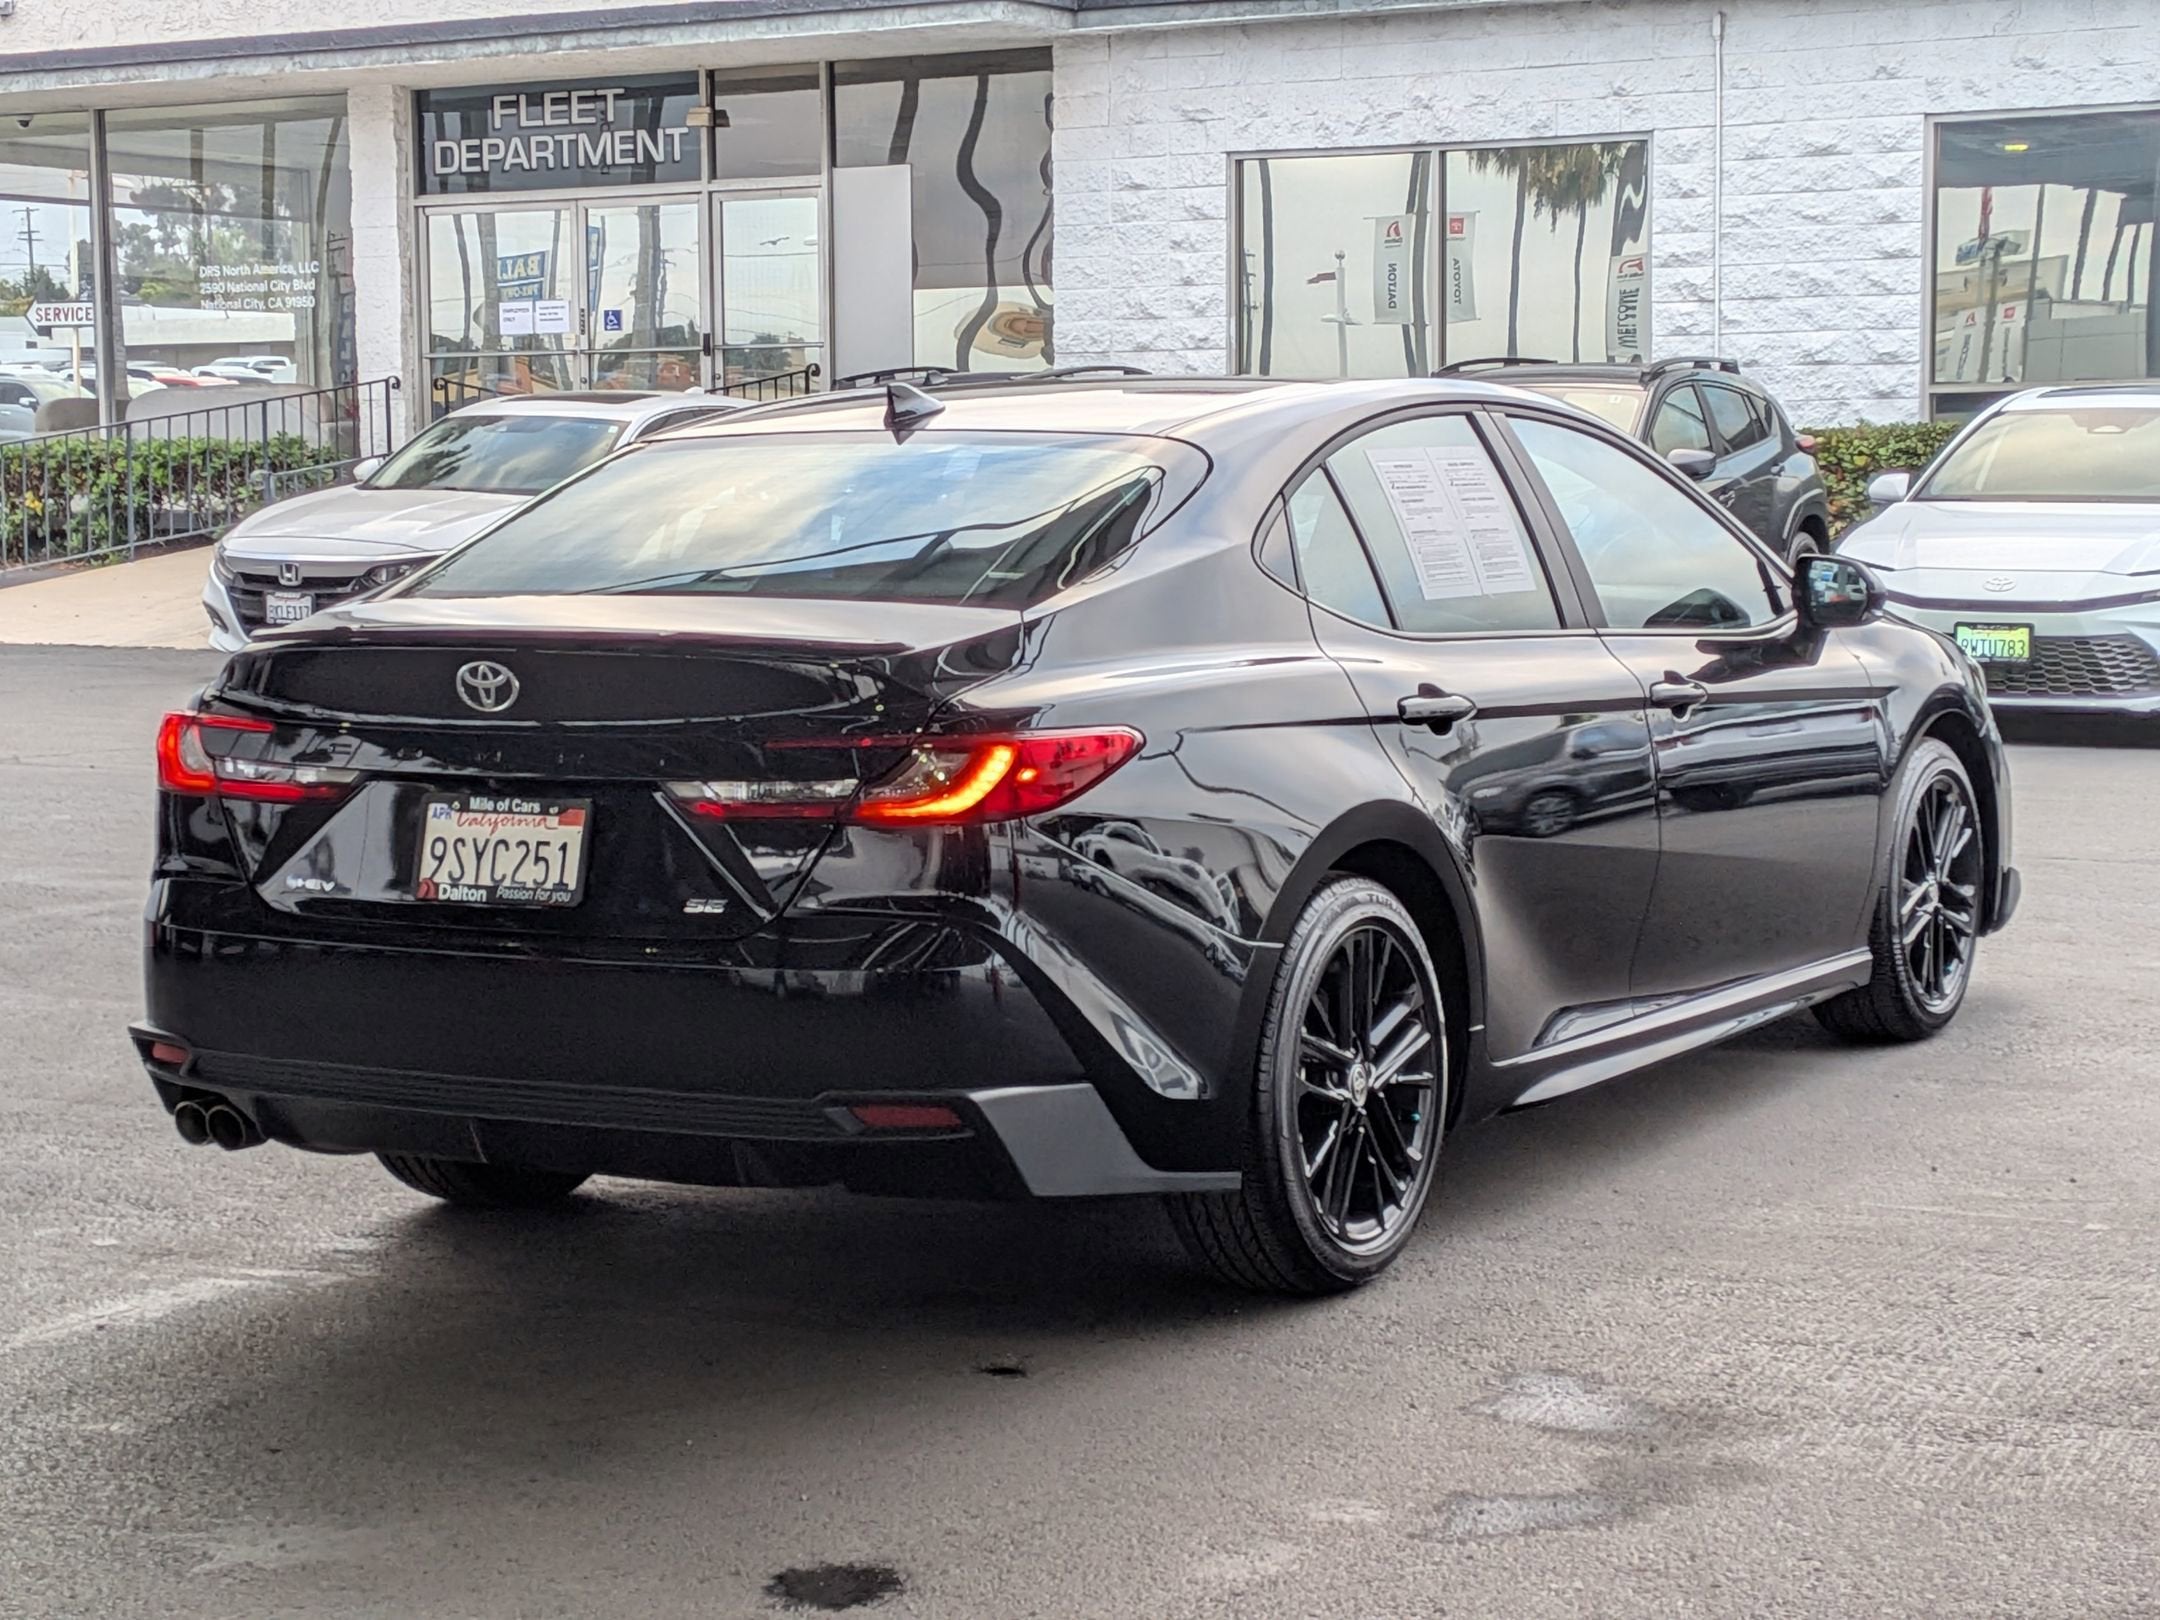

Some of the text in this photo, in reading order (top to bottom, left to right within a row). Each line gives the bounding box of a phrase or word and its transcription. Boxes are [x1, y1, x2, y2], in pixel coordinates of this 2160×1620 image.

[492, 87, 626, 129] FLEET
[433, 126, 690, 176] DEPARTMENT
[199, 260, 320, 278] DRS North America, LLC
[227, 280, 268, 293] National
[269, 279, 291, 294] City
[292, 277, 316, 291] Blvd
[200, 298, 242, 310] National
[267, 296, 284, 308] CA
[35, 306, 93, 322] SERVICE
[469, 797, 541, 813] Mile of Cars
[456, 811, 559, 836] California
[430, 836, 569, 889] 9SYC251
[438, 884, 487, 902] Dalton
[496, 886, 572, 904] Passion for you
[683, 898, 728, 913] SE
